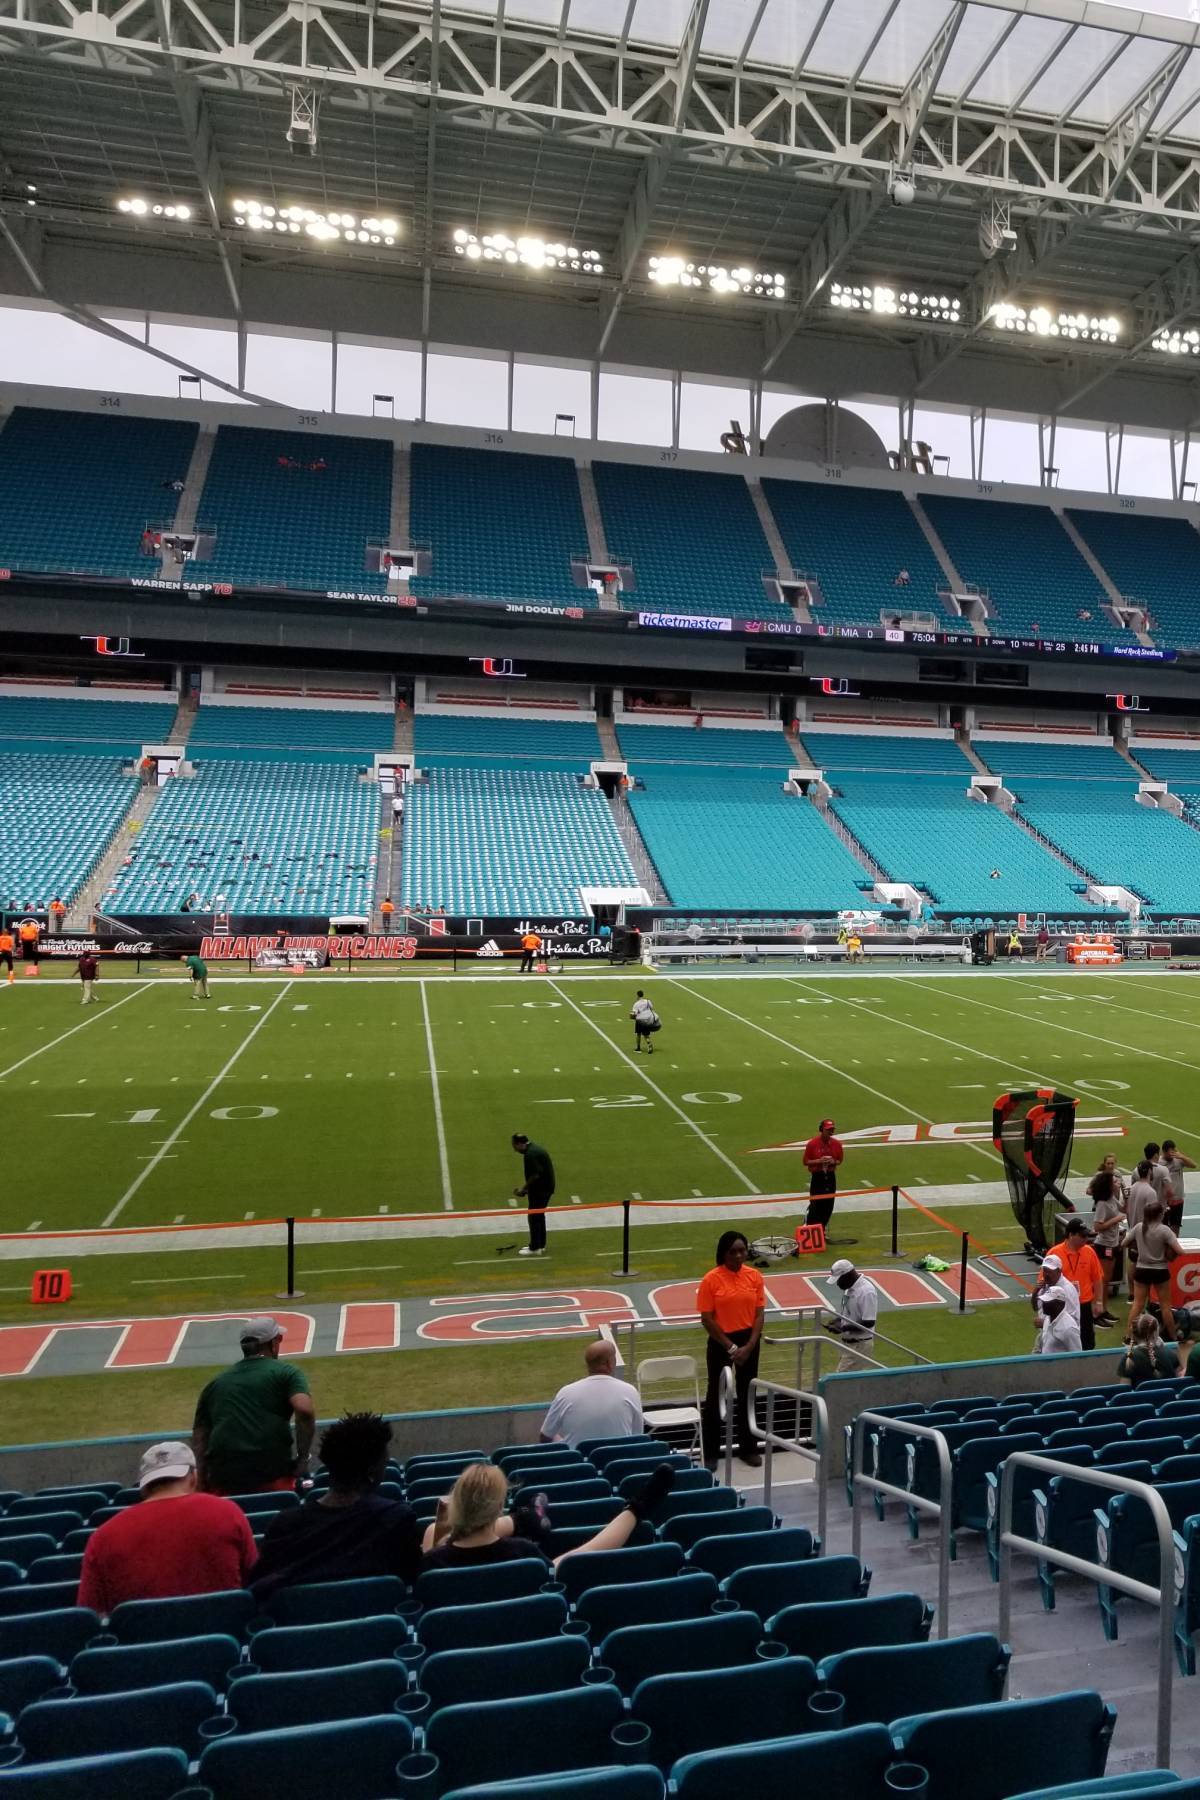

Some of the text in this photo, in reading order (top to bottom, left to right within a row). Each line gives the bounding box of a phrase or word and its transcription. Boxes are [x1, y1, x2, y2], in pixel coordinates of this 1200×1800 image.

[100, 397, 120, 406] 314
[298, 416, 318, 426] 315
[484, 434, 503, 444] 316
[660, 451, 677, 461] 317
[825, 467, 841, 478] 318
[978, 484, 993, 494] 319
[131, 578, 180, 590] WARREN
[183, 582, 212, 592] SAPP
[327, 591, 356, 600] SEAN
[358, 593, 397, 603] TAYLOR
[506, 604, 524, 613] JIM
[525, 605, 565, 616] DOOLEY
[643, 613, 722, 630] ticketmaster
[768, 622, 791, 633] CMU
[841, 629, 859, 638] MIA
[888, 632, 899, 640] 40
[912, 632, 936, 642] 75:04
[1010, 640, 1020, 648] 10
[1055, 643, 1098, 653] 25 2:45 PM
[514, 920, 588, 935] Hialeah Park
[114, 941, 153, 953] Coca-Cola
[590, 1091, 743, 1108] 20
[108, 1105, 280, 1124] 10
[801, 1227, 824, 1251] 20
[1177, 1263, 1200, 1293] G
[38, 1273, 63, 1300] 10
